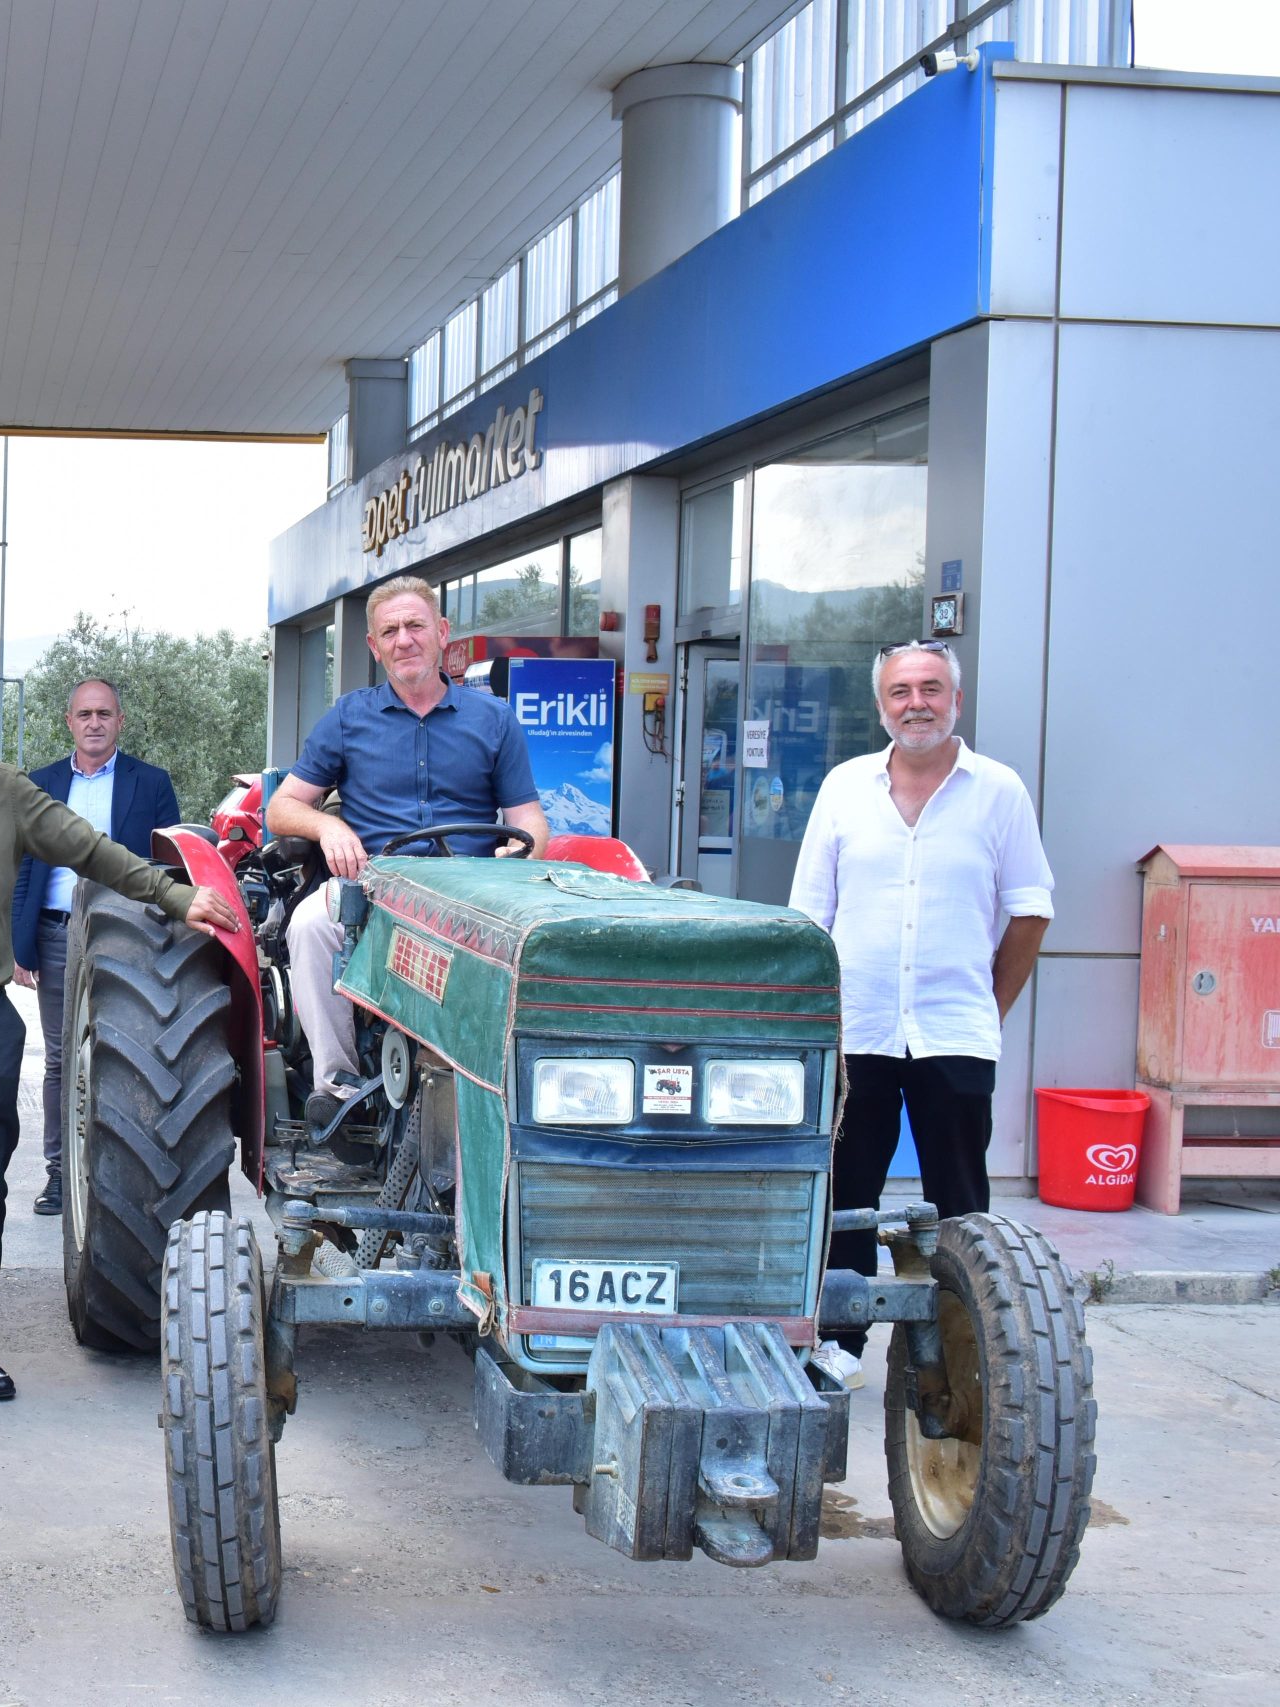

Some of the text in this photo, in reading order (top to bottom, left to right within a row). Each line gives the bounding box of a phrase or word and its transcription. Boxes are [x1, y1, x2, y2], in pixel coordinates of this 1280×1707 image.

[409, 387, 544, 529] fullmarket
[939, 608, 949, 620] 32
[516, 692, 607, 726] Erikli
[558, 729, 593, 737] zirvesinden
